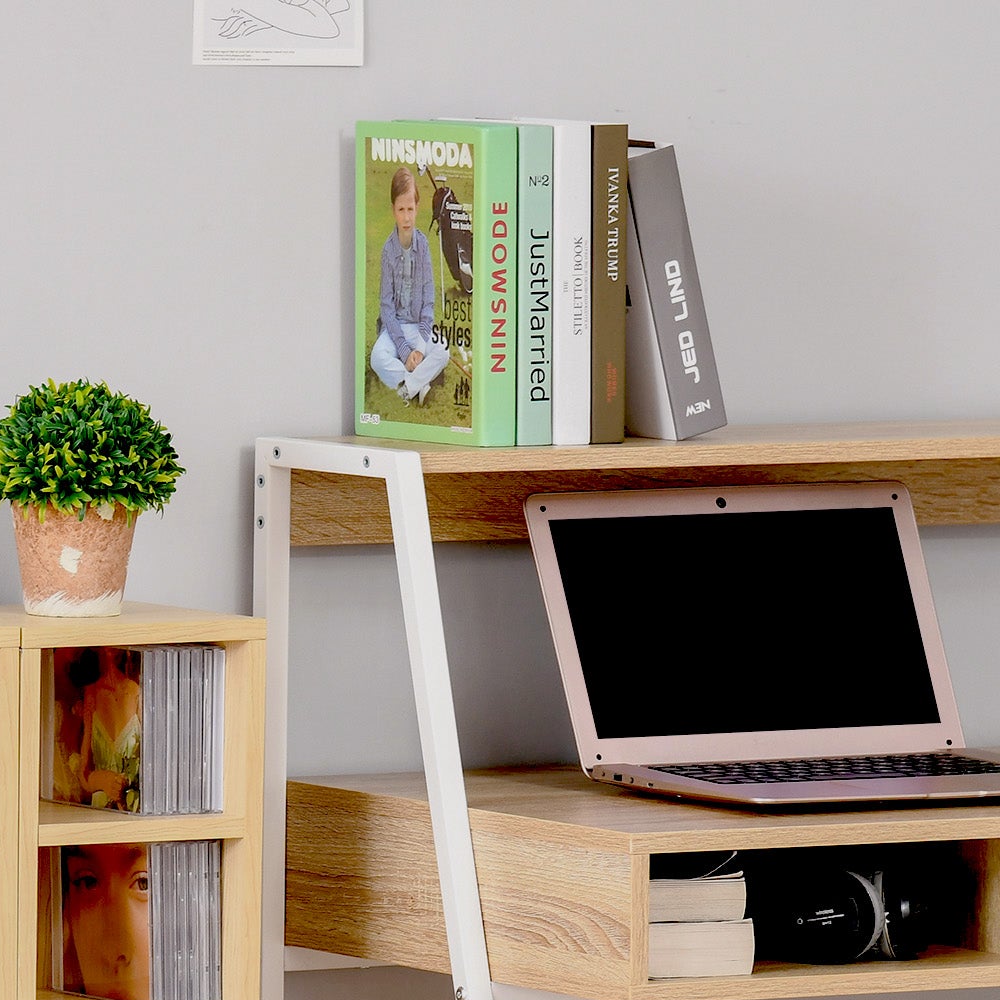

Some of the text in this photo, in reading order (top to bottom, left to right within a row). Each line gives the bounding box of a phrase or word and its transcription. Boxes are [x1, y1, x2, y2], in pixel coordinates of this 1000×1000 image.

[371, 137, 473, 168] NINSMODA
[607, 168, 619, 282] IVANKA TRUMP
[431, 320, 471, 351] styles
[444, 293, 472, 322] best
[491, 202, 508, 373] NINSMODE
[530, 229, 550, 402] JustMarried
[573, 236, 583, 336] STILETTO BOOK
[664, 259, 700, 384] JED LIND
[686, 399, 712, 417] NEW
